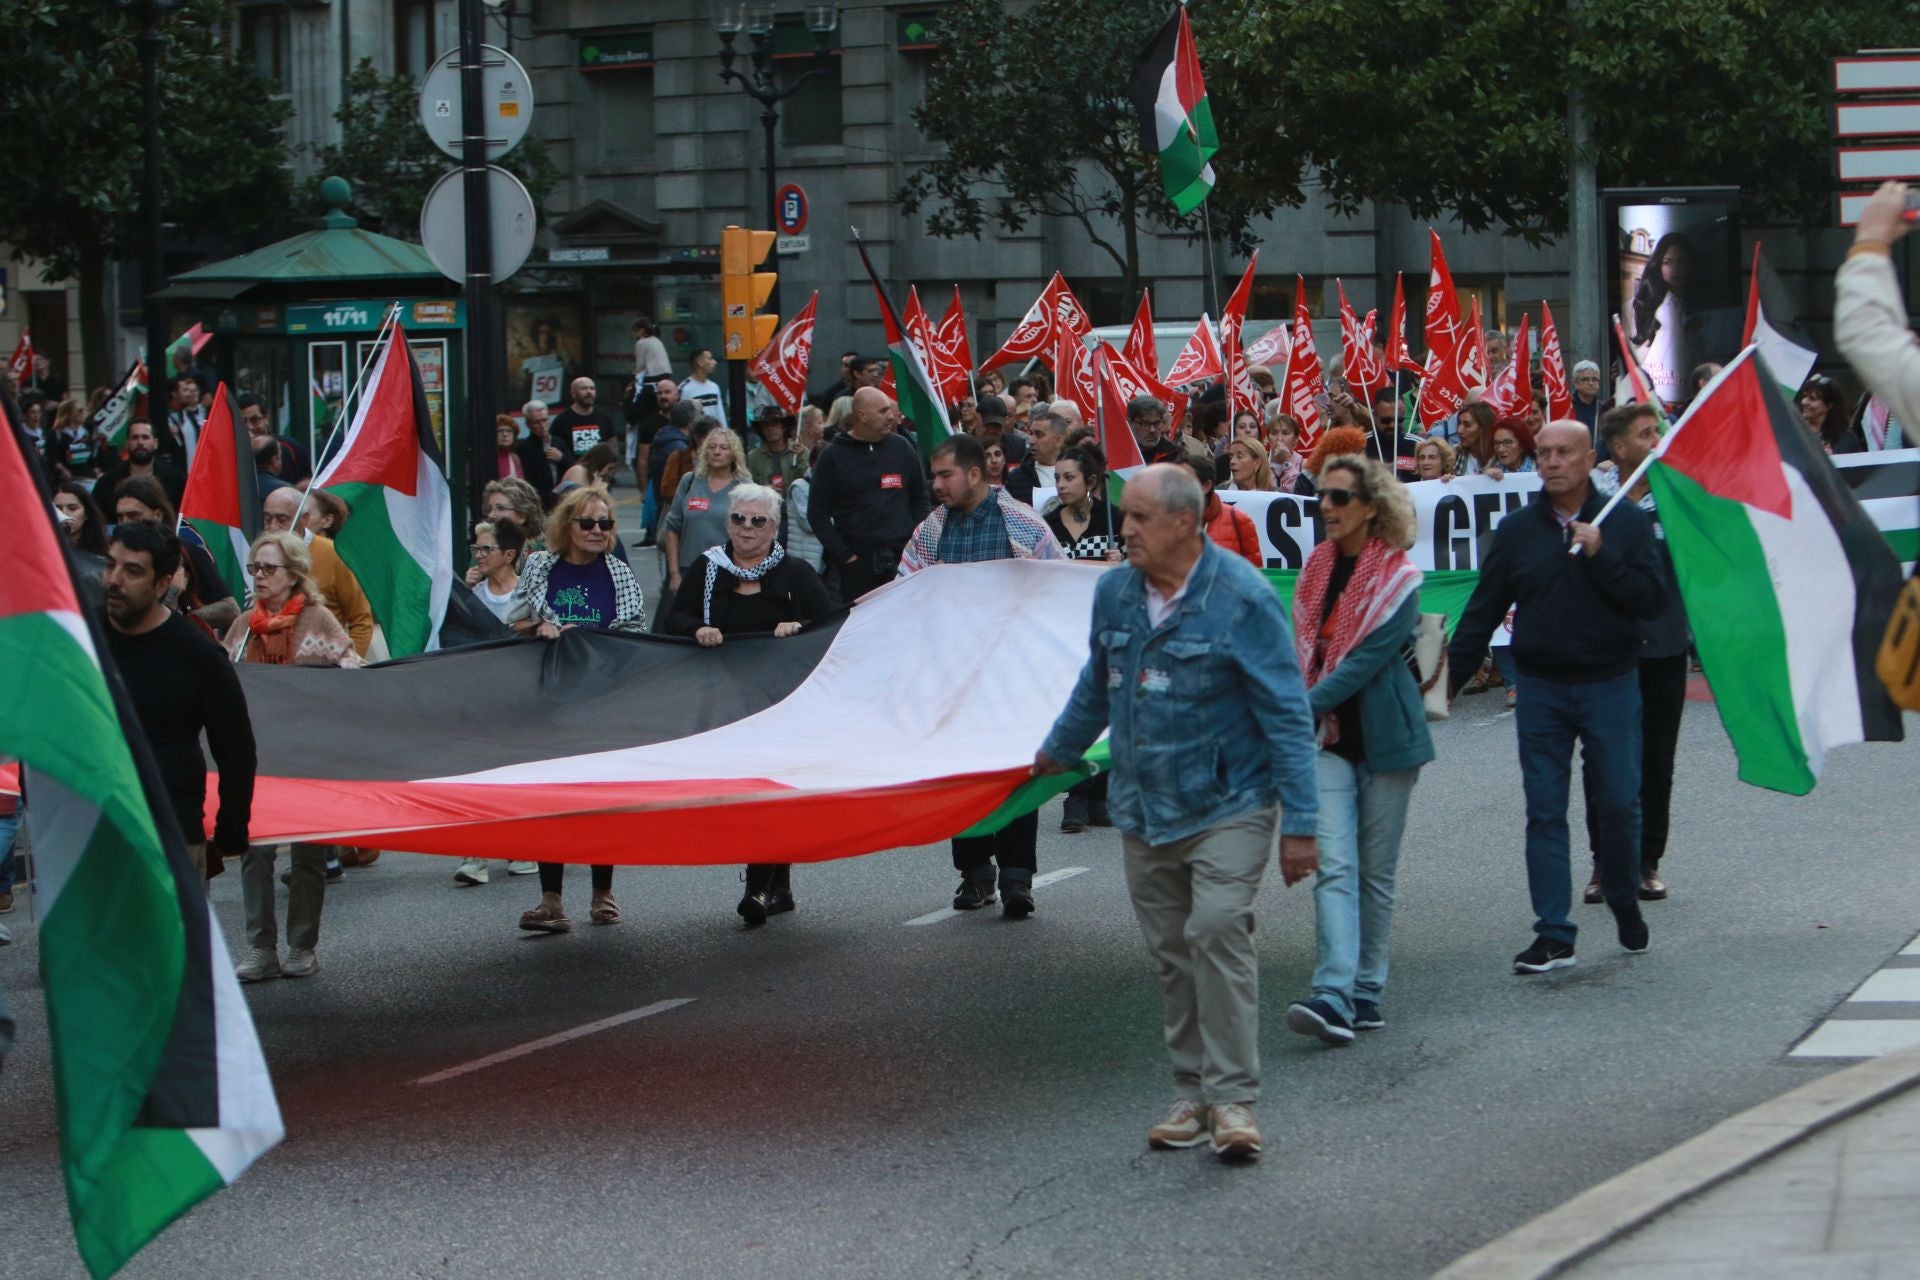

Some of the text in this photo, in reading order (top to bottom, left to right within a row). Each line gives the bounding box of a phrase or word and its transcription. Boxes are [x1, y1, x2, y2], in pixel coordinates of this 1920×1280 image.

[787, 202, 796, 217] P
[323, 311, 368, 326] 11/11
[536, 375, 558, 393] 50
[572, 428, 601, 441] FCK
